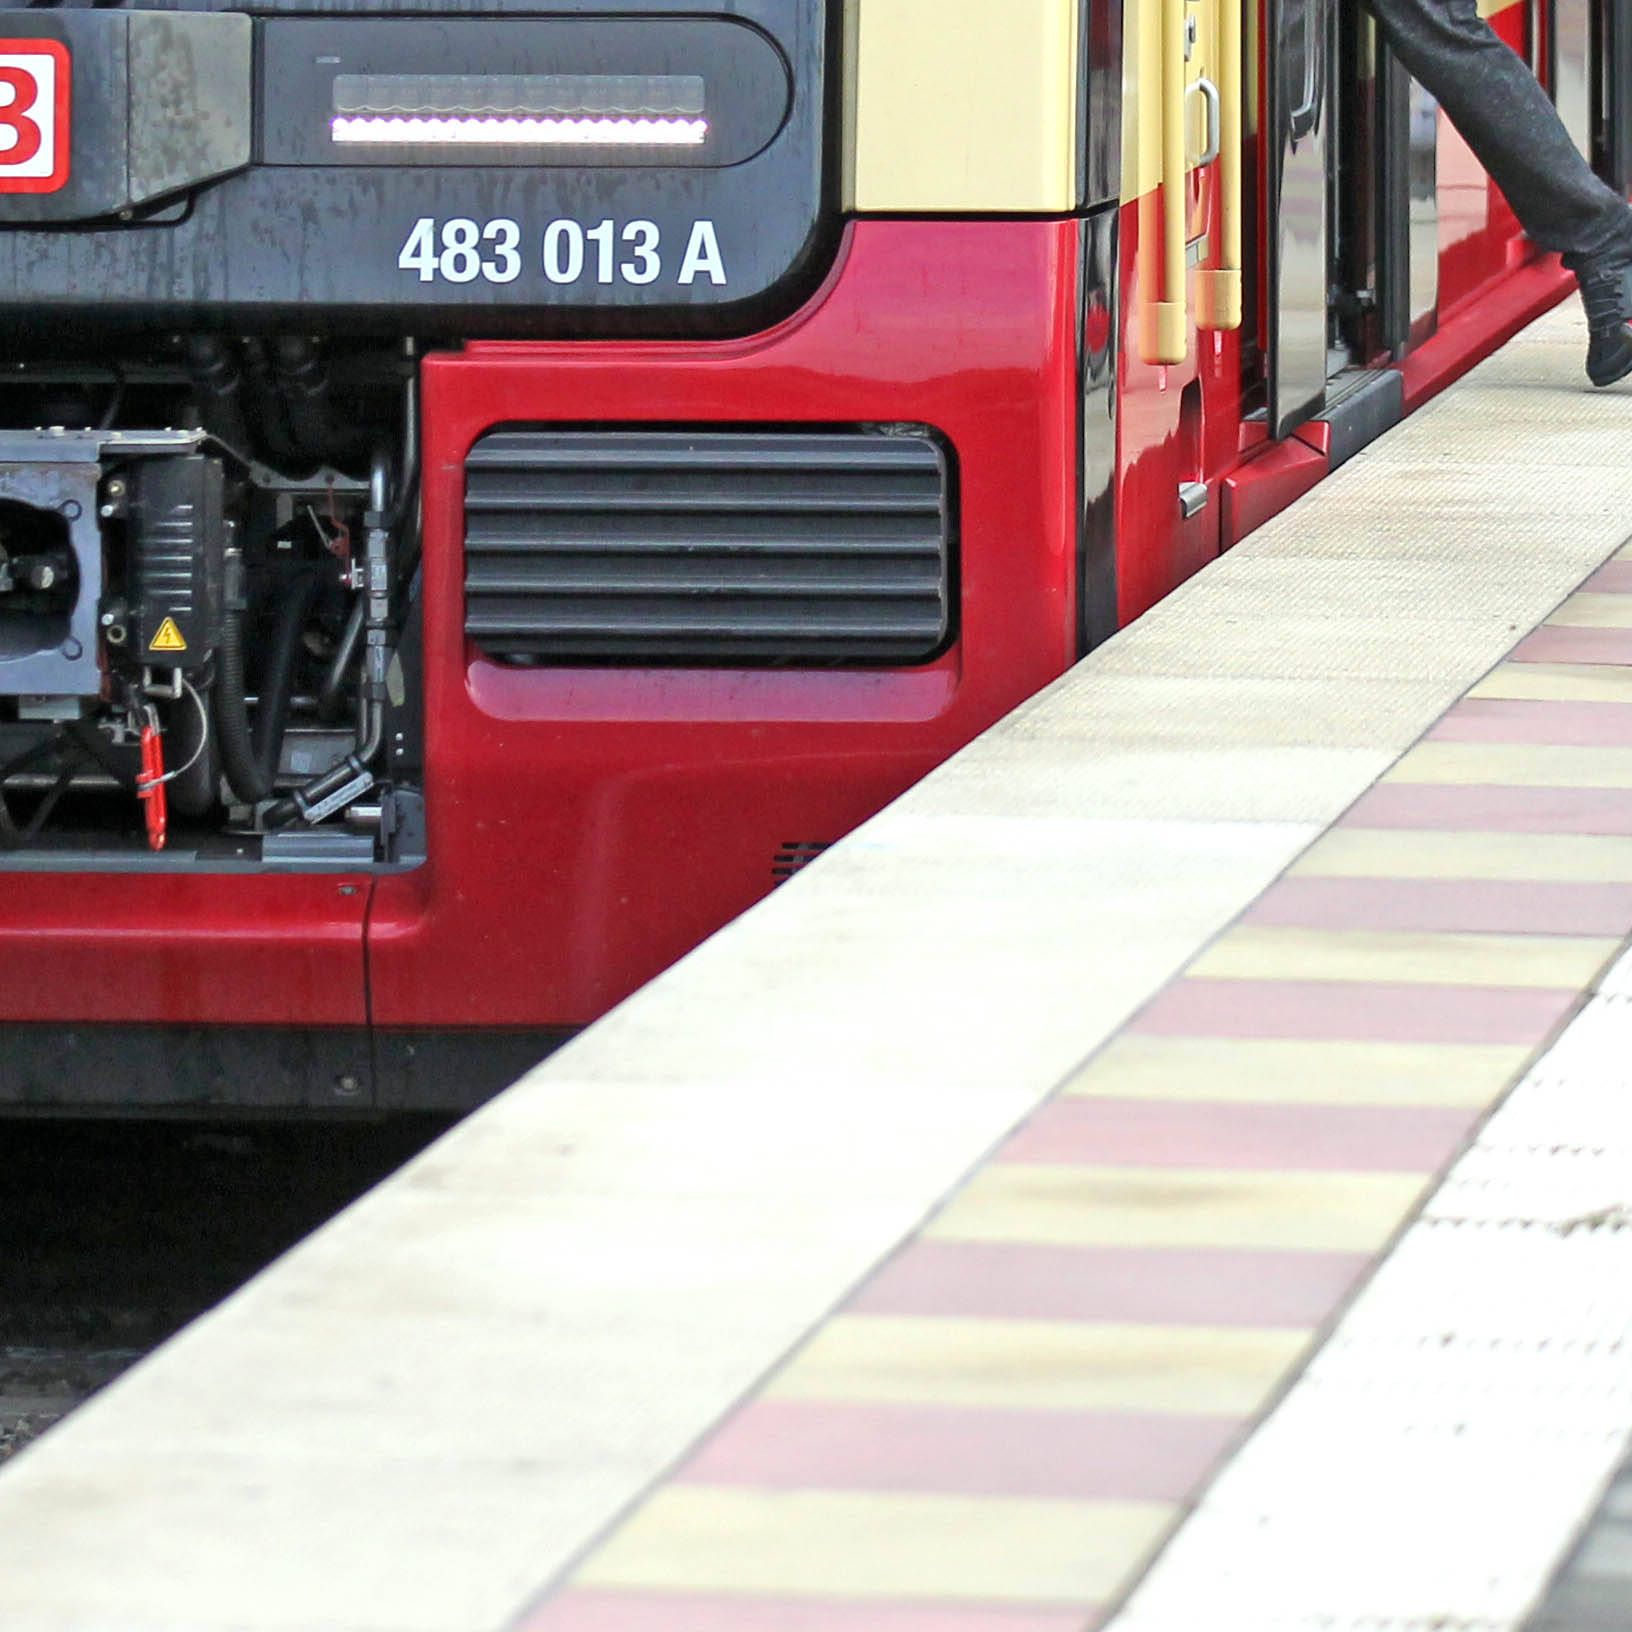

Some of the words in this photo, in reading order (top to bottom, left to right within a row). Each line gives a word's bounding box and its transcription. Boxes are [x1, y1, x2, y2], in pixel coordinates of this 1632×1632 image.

[398, 217, 521, 284] 483
[542, 218, 661, 285] 013
[676, 220, 727, 285] A
